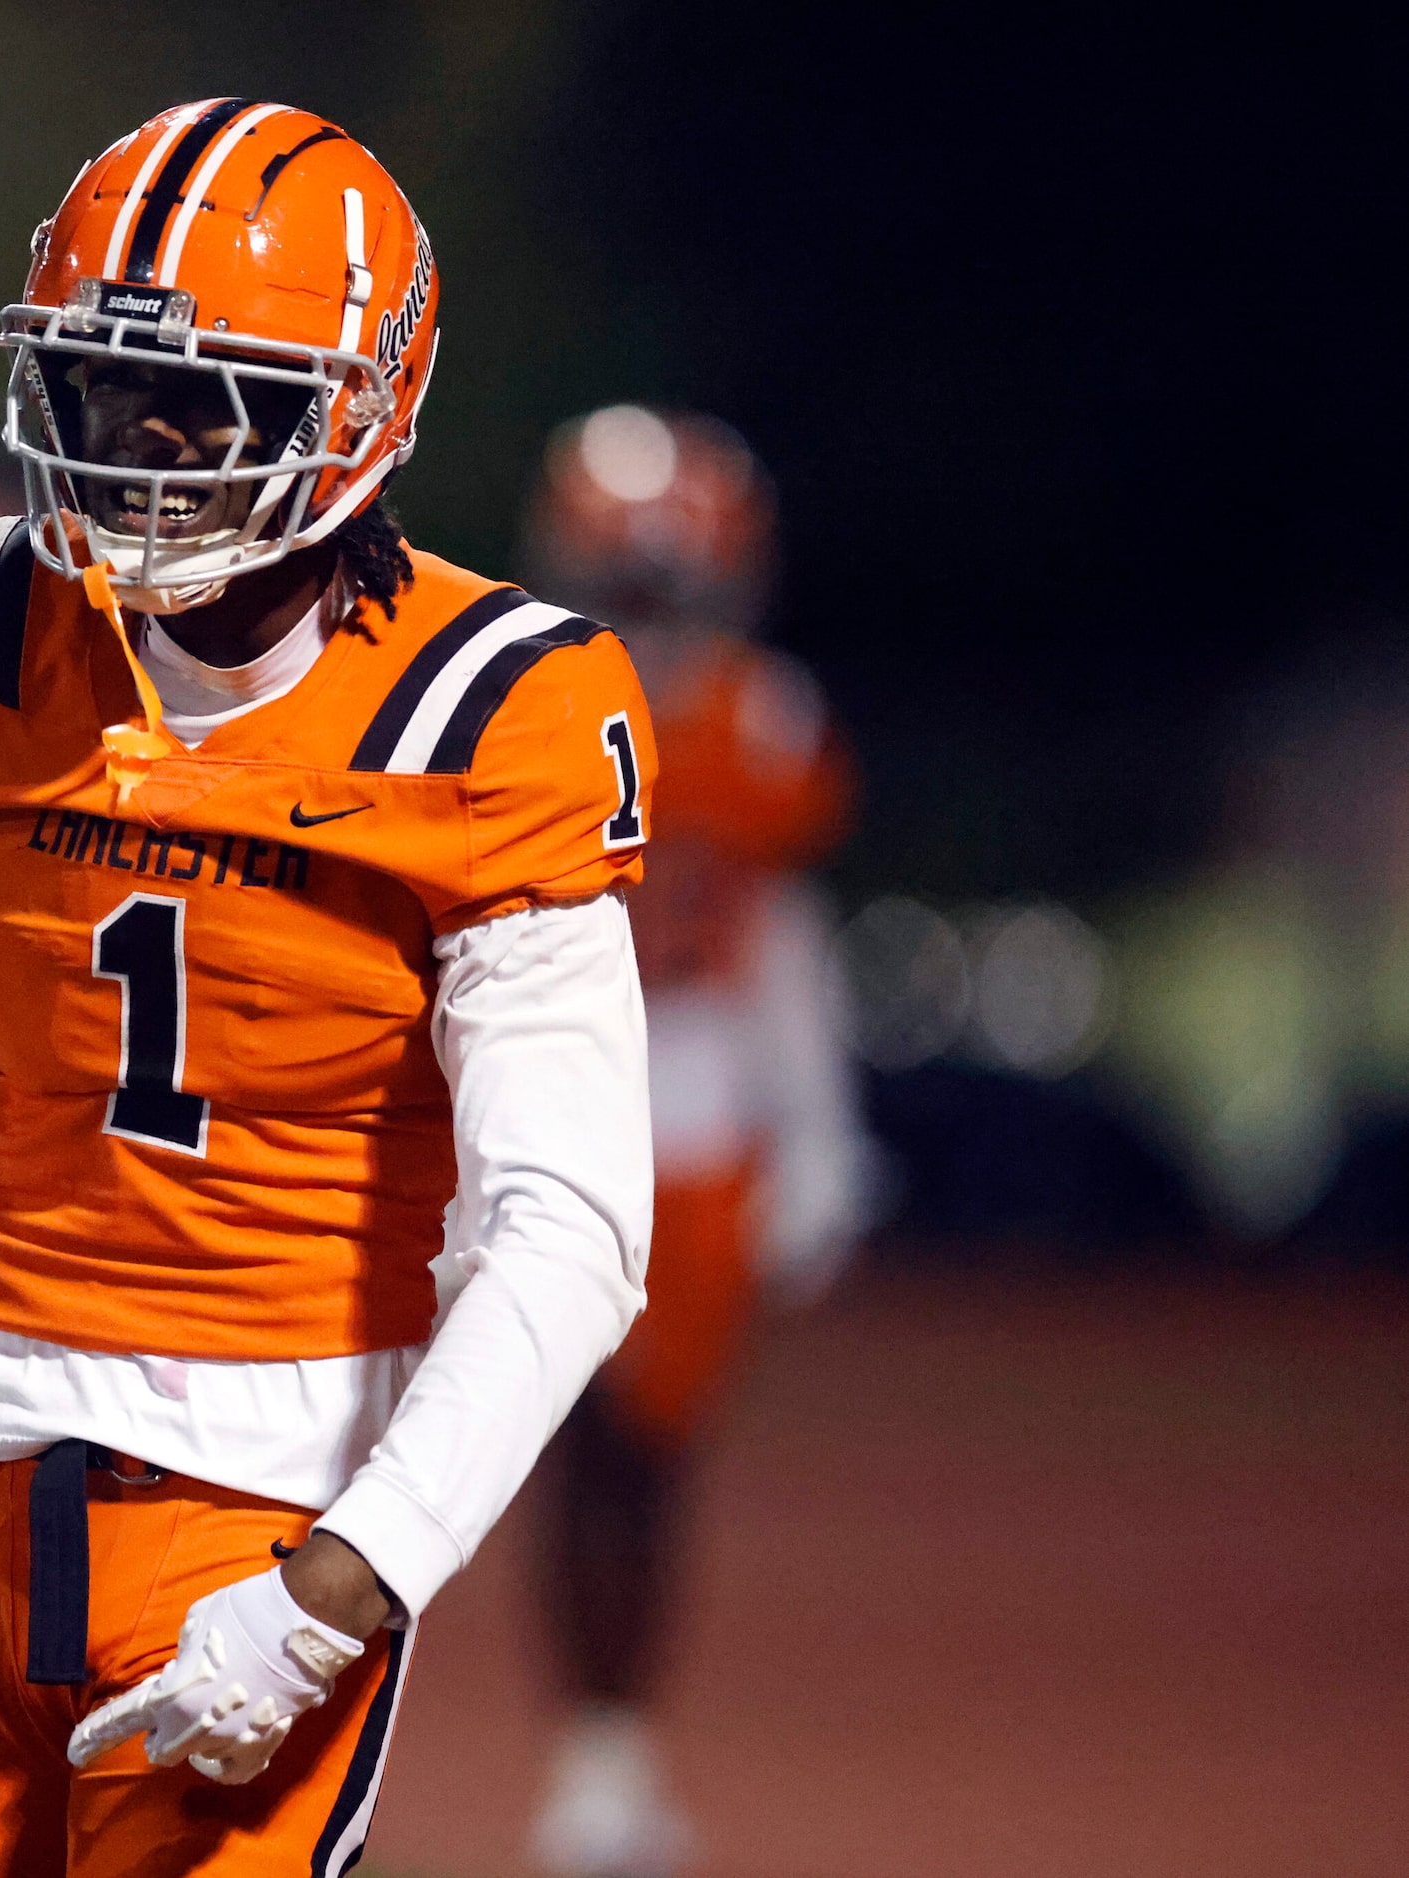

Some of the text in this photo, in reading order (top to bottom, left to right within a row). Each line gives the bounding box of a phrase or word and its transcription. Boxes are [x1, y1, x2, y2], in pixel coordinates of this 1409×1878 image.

[107, 293, 163, 314] schutt
[600, 710, 647, 851] 1
[28, 808, 310, 890] LANCASTER
[92, 891, 211, 1159] 1
